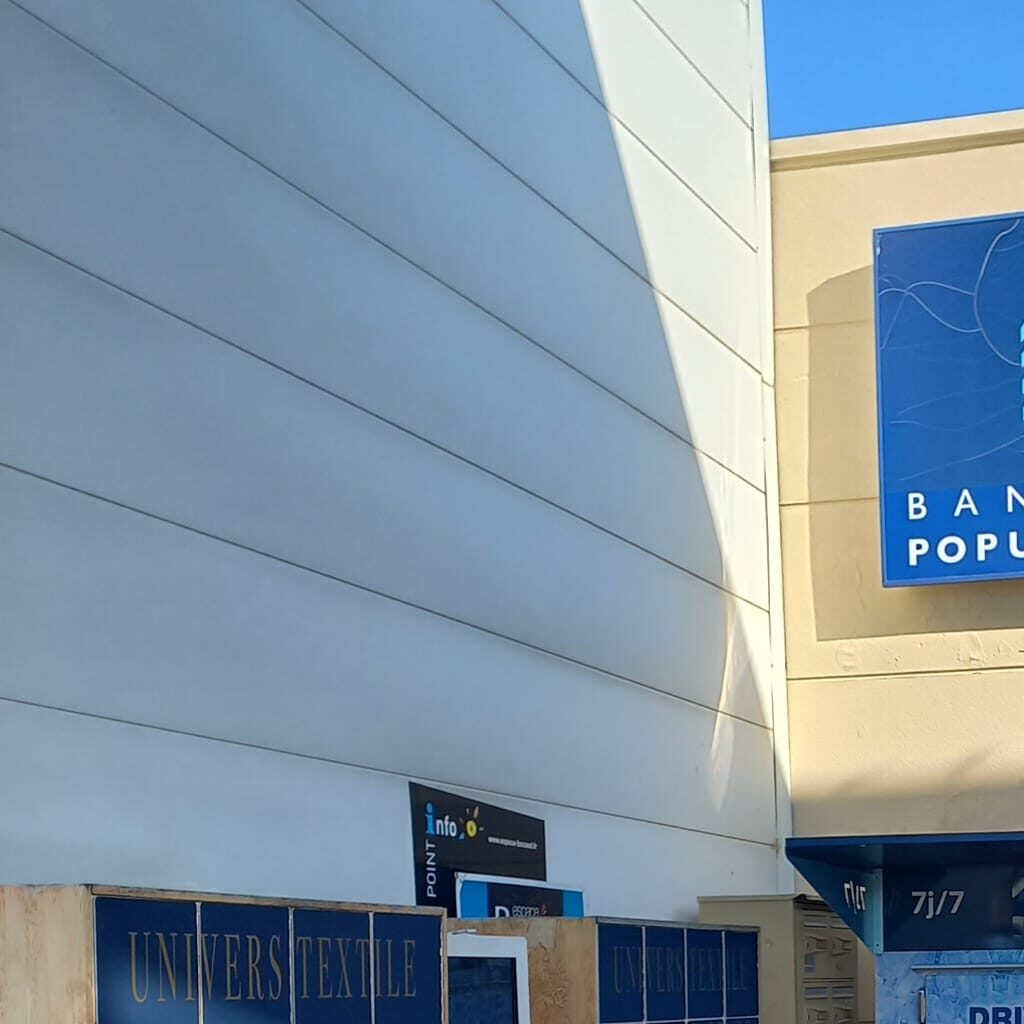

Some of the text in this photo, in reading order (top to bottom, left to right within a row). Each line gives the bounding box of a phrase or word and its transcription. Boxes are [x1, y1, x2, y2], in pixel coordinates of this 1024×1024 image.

[425, 802, 458, 837] info
[426, 839, 437, 897] POINT
[911, 890, 965, 919] 7j/7
[128, 931, 417, 1002] UNIVERS TEXTILE
